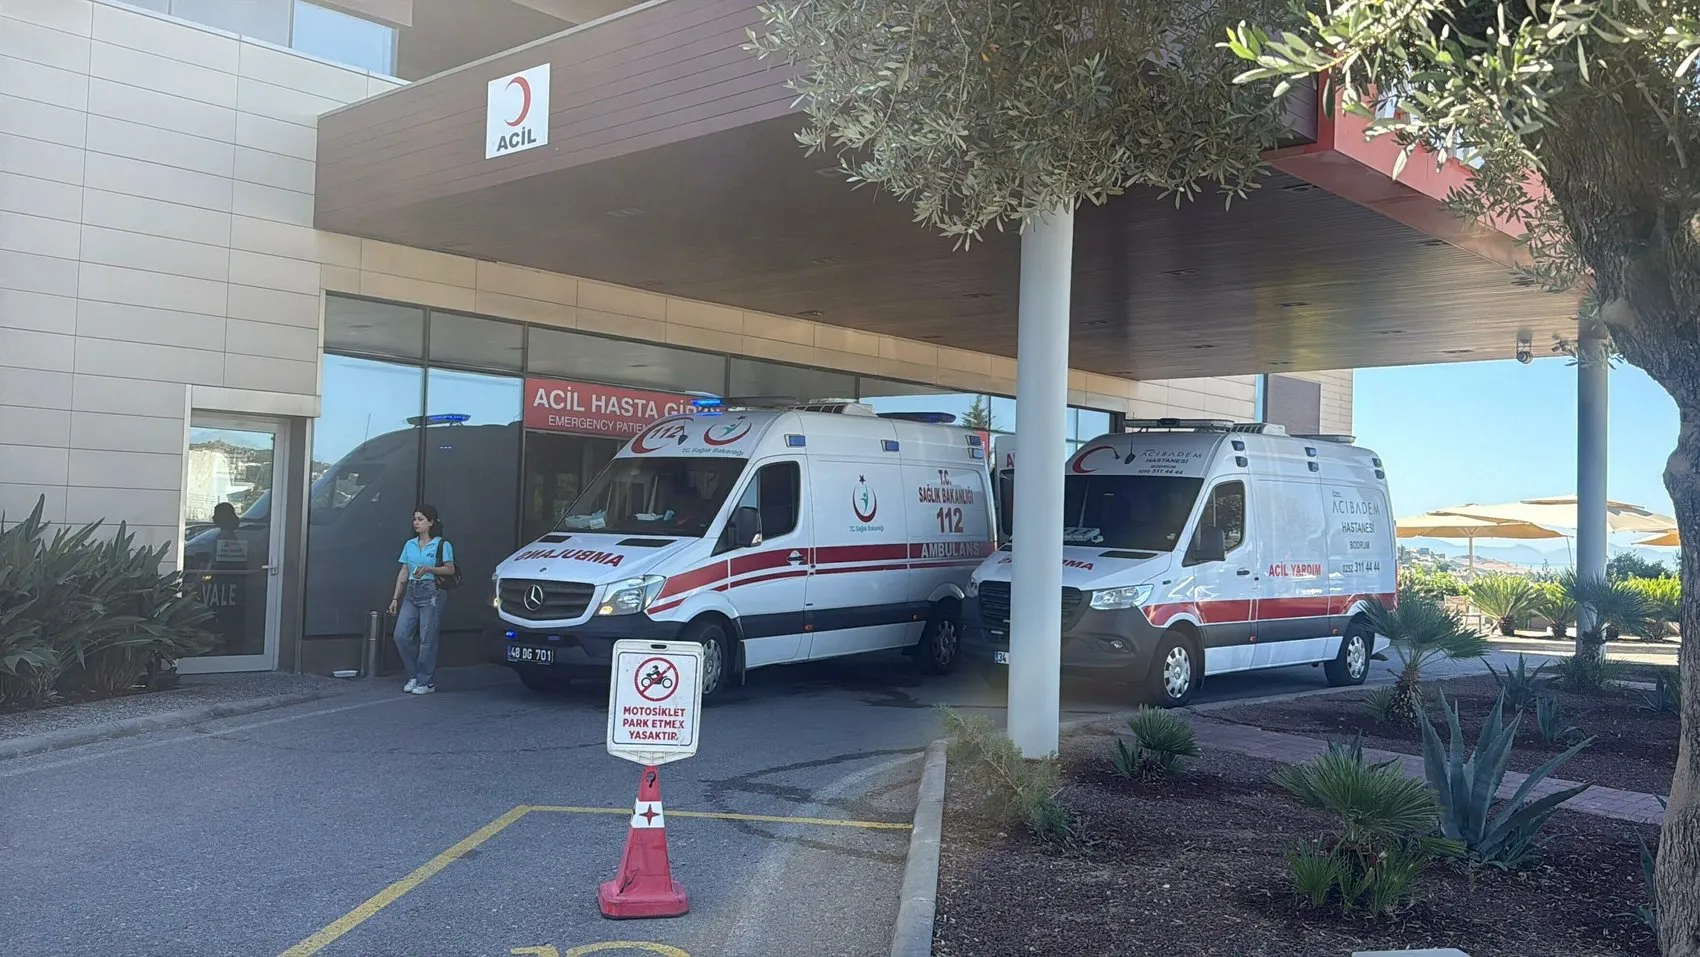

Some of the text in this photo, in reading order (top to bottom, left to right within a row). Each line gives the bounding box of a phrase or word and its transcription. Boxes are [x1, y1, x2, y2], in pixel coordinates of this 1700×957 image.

[496, 126, 537, 152] ACİL
[533, 386, 585, 412] ACİL
[591, 394, 659, 420] HASTA
[548, 414, 615, 431] EMERGENCY
[649, 425, 685, 440] 112
[1332, 500, 1380, 516] ACIBADEM
[936, 507, 964, 533] 112
[921, 542, 980, 558] AMBULANS
[1268, 561, 1321, 577] ACİL YARDIM
[1354, 561, 1364, 573] 311
[1365, 561, 1373, 573] 44
[1373, 561, 1381, 573] 44
[511, 646, 551, 662] 48 DG 701
[623, 705, 686, 718] MOTOSİKLET
[622, 718, 649, 728] PARK
